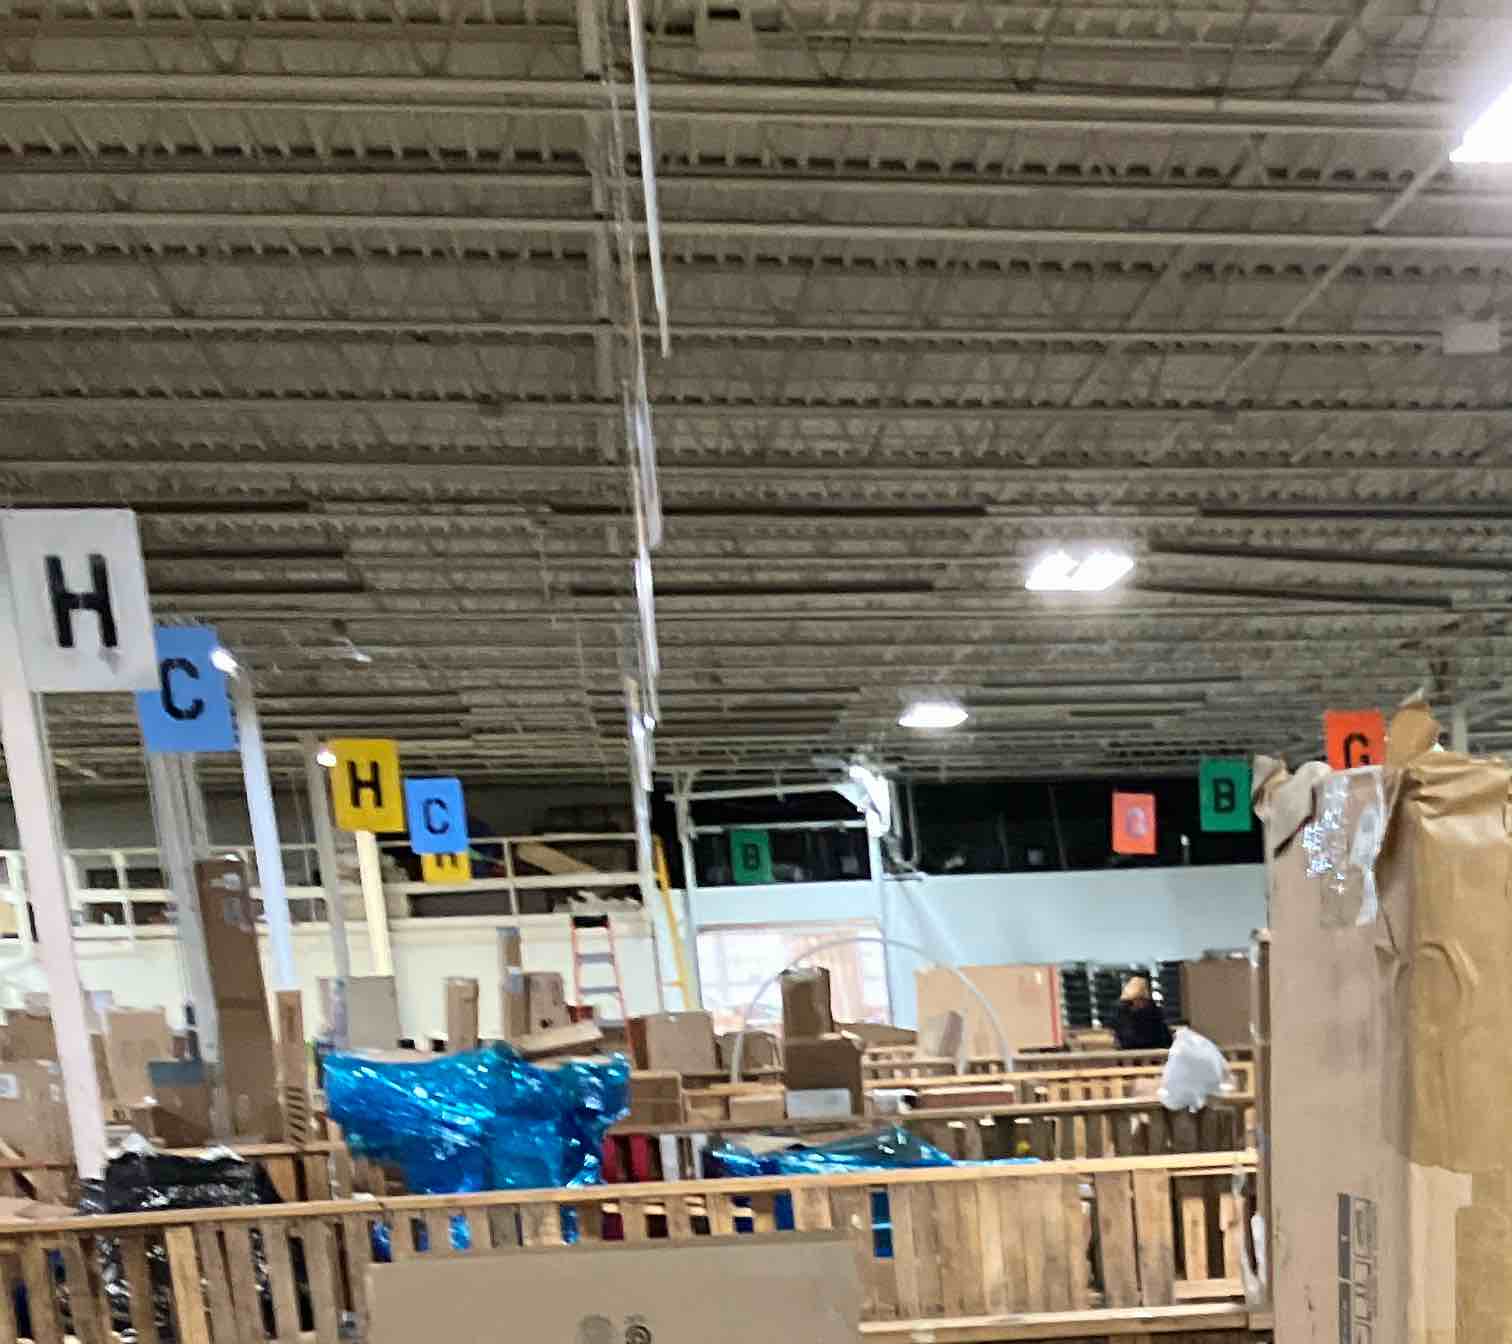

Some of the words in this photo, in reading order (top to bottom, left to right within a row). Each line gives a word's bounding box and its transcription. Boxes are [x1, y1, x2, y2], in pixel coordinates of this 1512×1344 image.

[46, 553, 118, 649] H
[160, 657, 205, 721] C
[349, 760, 384, 809] H
[1213, 779, 1236, 813] B
[424, 796, 451, 835] C
